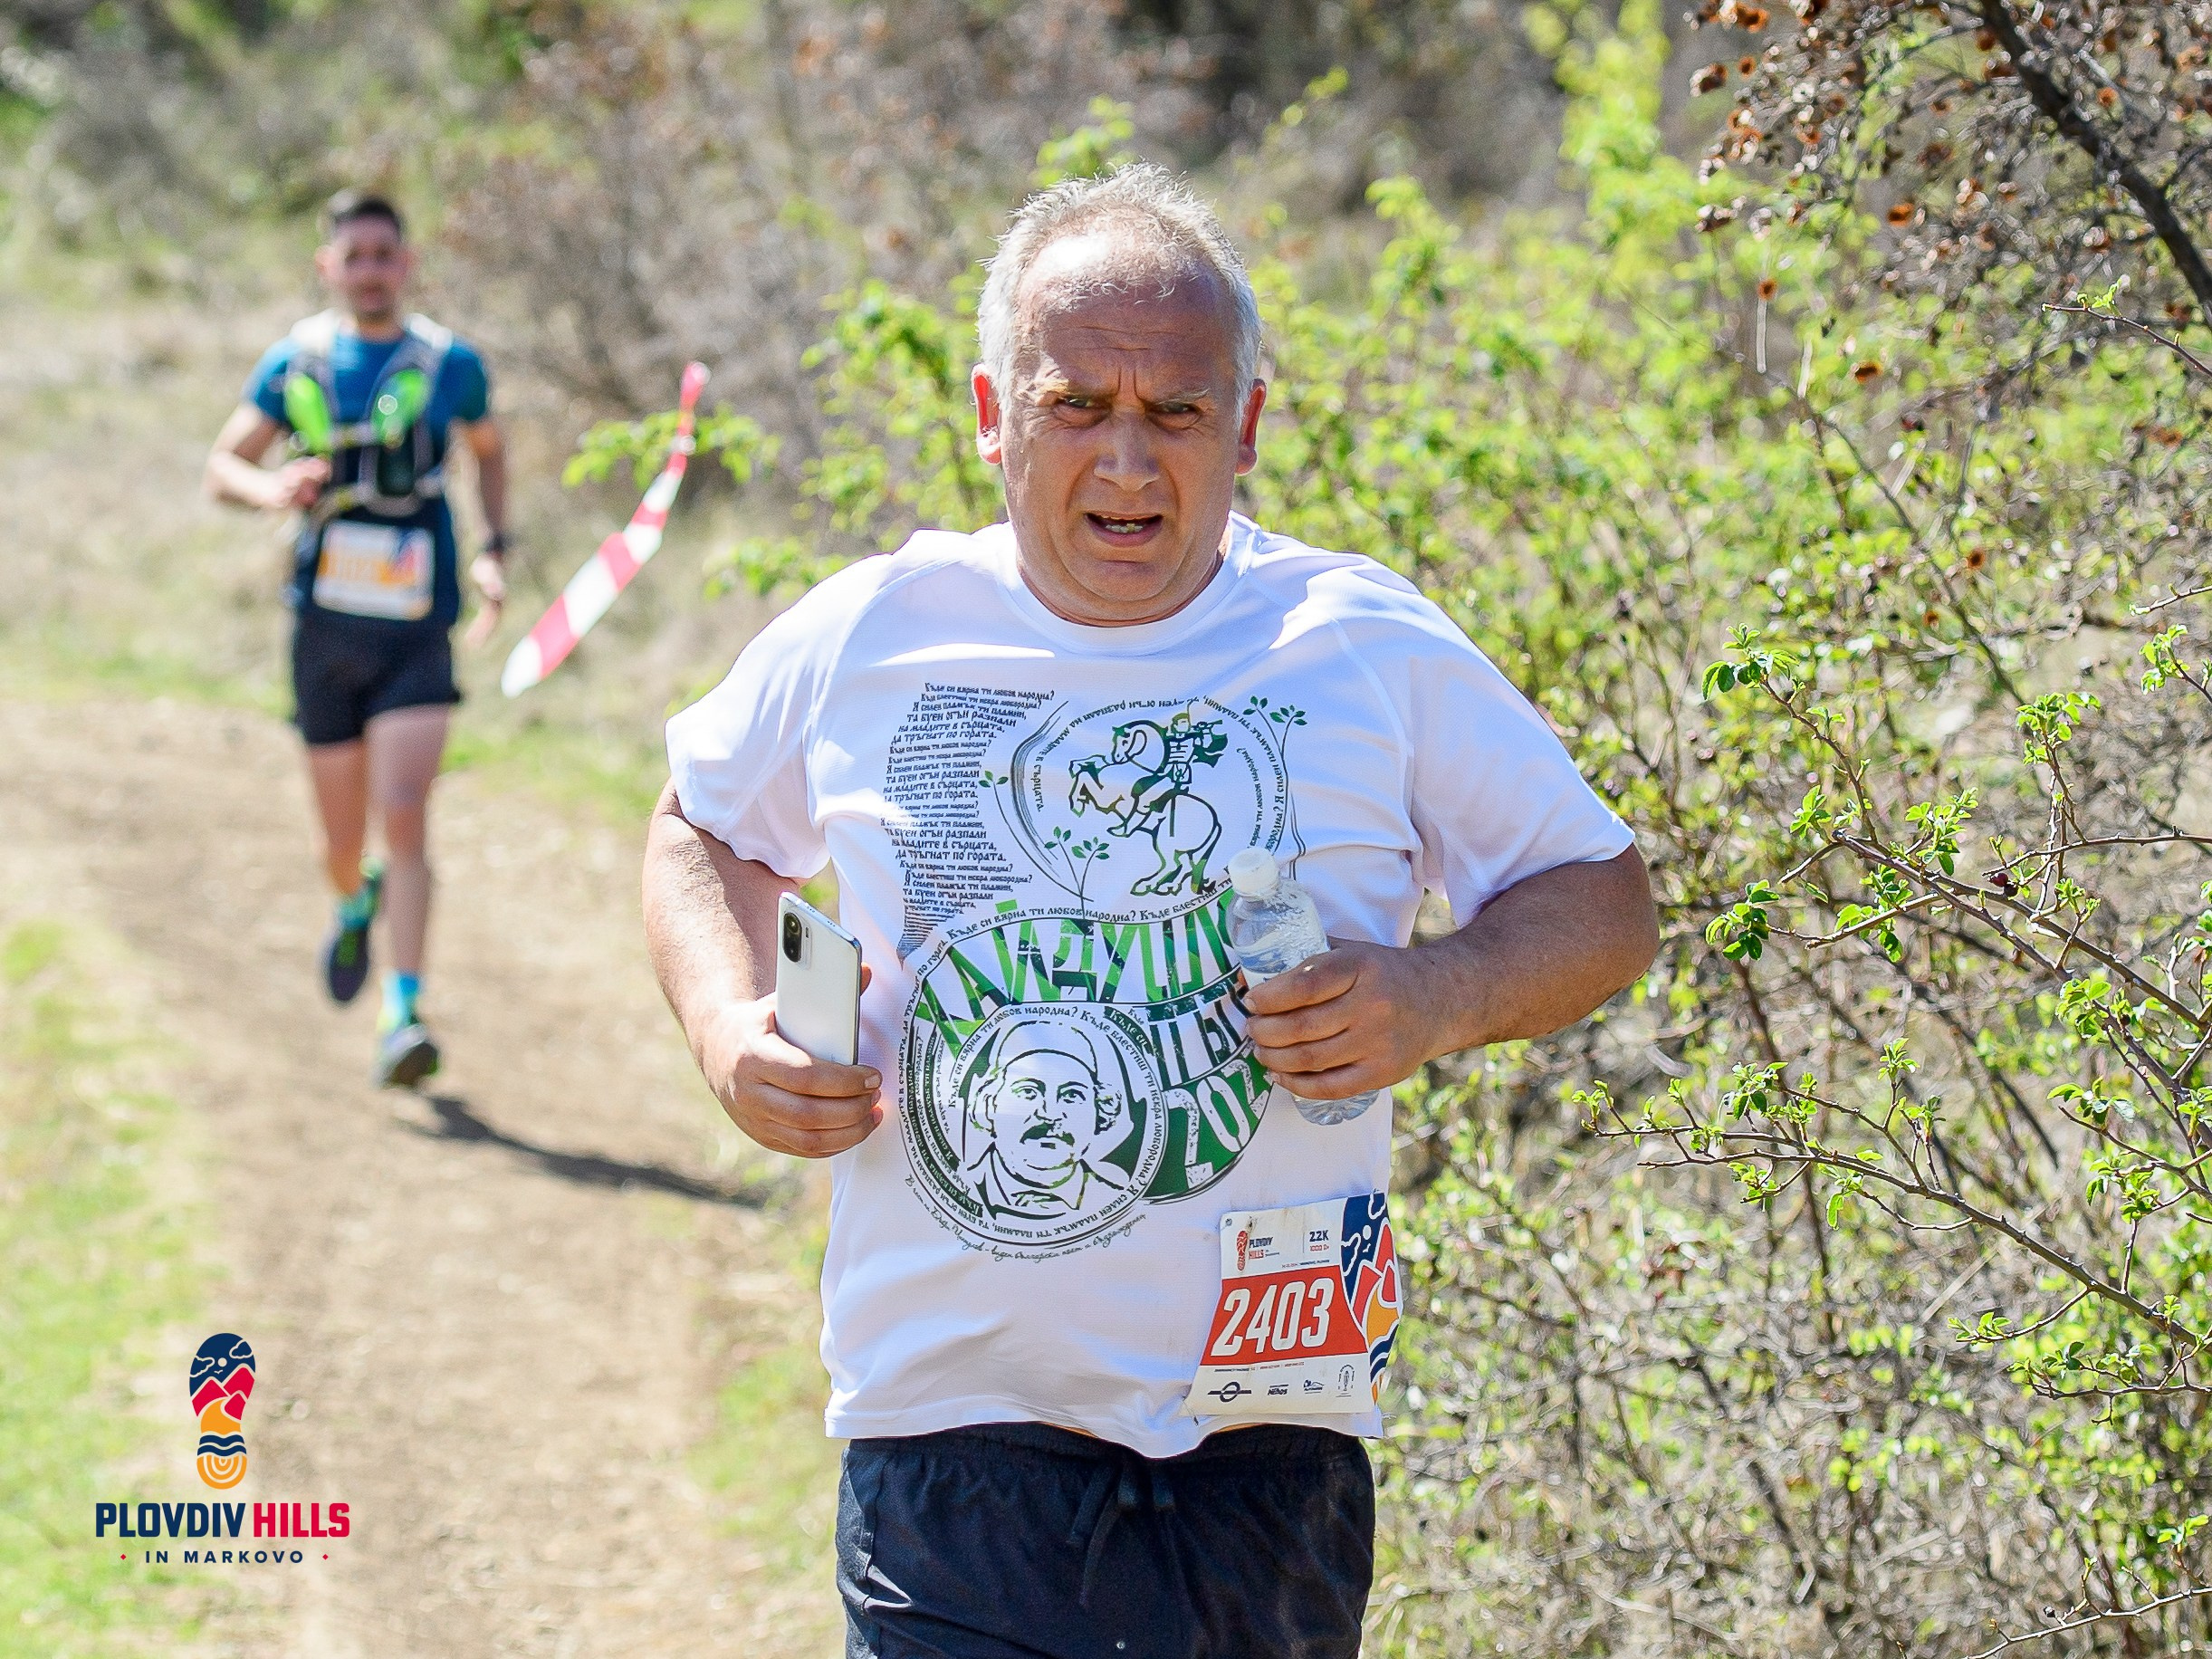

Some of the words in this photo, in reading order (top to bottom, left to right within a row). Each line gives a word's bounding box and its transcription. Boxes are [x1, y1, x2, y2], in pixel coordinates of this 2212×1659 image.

[946, 924, 979, 940] Къде
[980, 917, 992, 929] си
[994, 910, 1027, 925] вярна
[1029, 907, 1046, 916] ти
[1047, 907, 1084, 916] любов
[1086, 909, 1137, 924] народна?
[1140, 906, 1171, 922] Къде
[1173, 888, 1219, 915] блестиш
[916, 964, 928, 976] по
[1024, 1005, 1078, 1018] народна?
[1080, 1010, 1111, 1033] Къде
[903, 1020, 909, 1034] да
[980, 1021, 994, 1034] ти
[960, 1033, 982, 1062] вярна
[1110, 1030, 1148, 1071] блестиш
[897, 1035, 908, 1085] сърцата,
[954, 1061, 963, 1075] си
[1144, 1071, 1155, 1088] ти
[948, 1078, 960, 1108] Къде
[1150, 1089, 1163, 1120] искра
[898, 1097, 914, 1144] младите
[1163, 1043, 1278, 1189] 202
[911, 1146, 919, 1160] на
[1135, 1122, 1163, 1186] любородна?
[915, 1159, 942, 1194] разпали
[1126, 1184, 1140, 1197] Я
[939, 1193, 958, 1212] огън
[1098, 1194, 1128, 1217] силен
[958, 1208, 978, 1224] буен
[978, 1220, 990, 1230] та
[1054, 1213, 1099, 1235] пламък
[991, 1222, 1033, 1238] пламни,
[1036, 1230, 1053, 1239] ти
[1309, 1230, 1329, 1242] 22K
[1210, 1277, 1336, 1357] 2403
